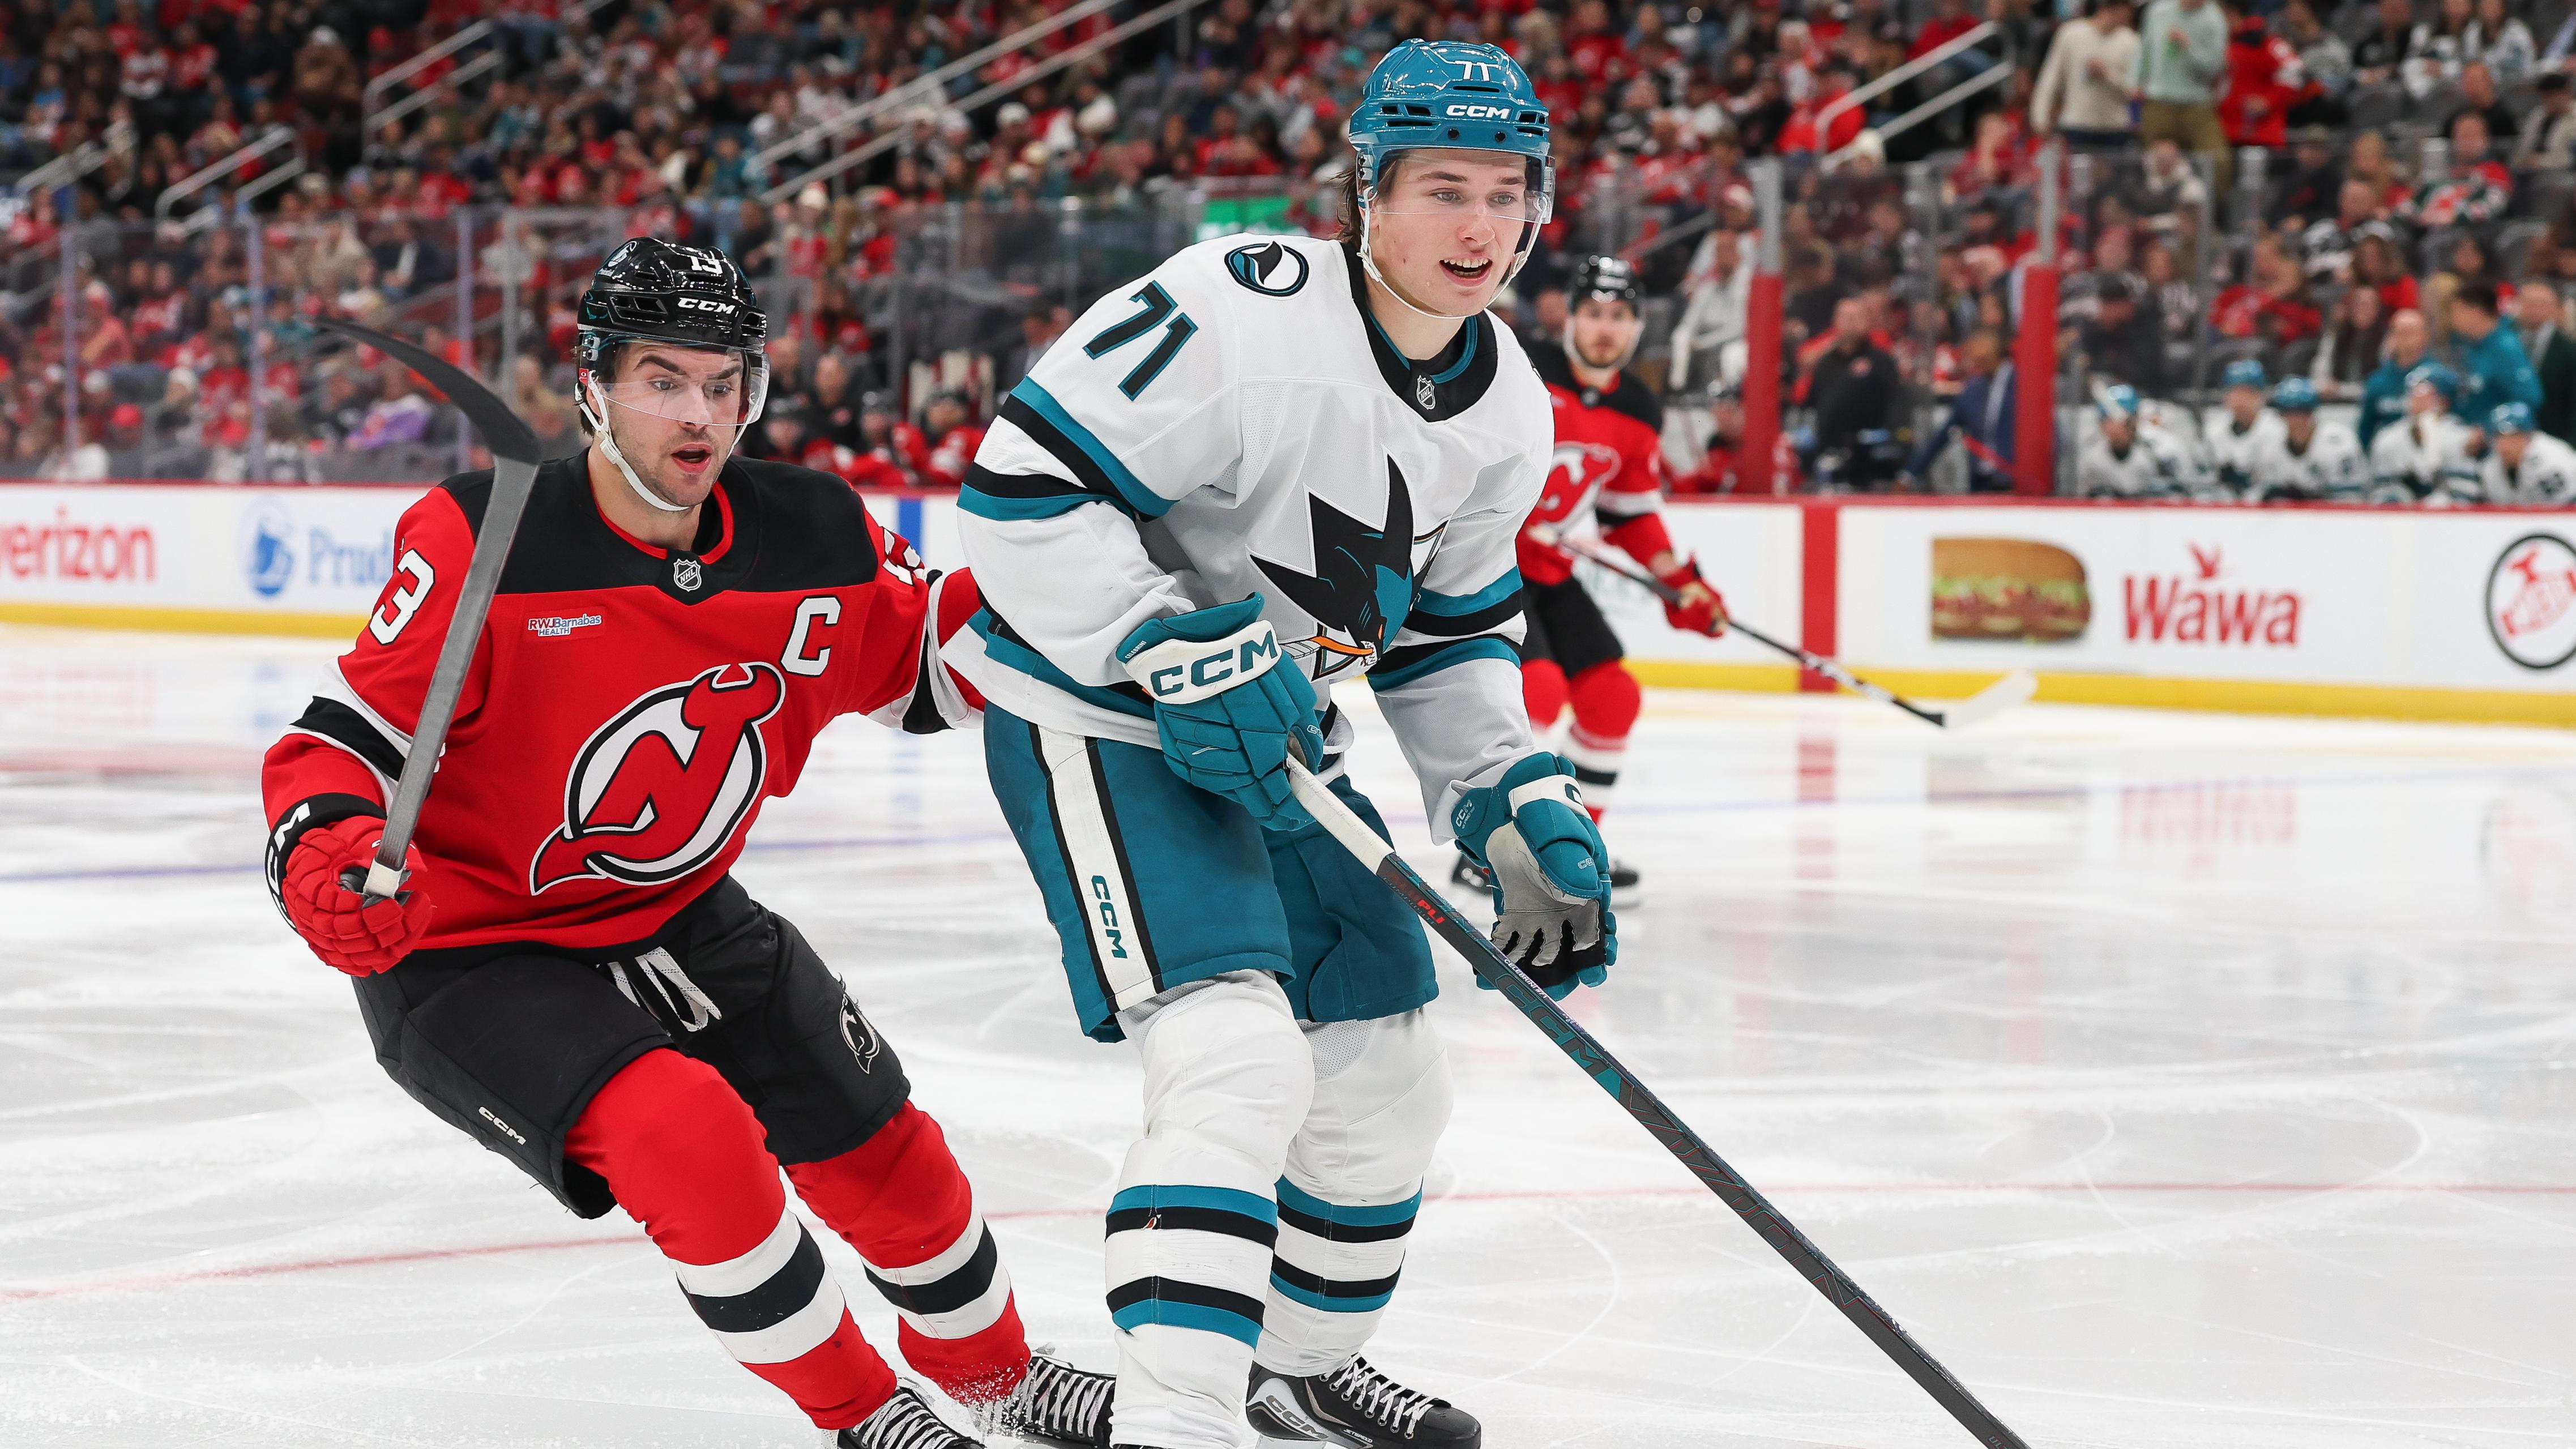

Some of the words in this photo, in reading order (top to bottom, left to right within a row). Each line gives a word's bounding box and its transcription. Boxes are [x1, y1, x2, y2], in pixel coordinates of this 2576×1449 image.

[1455, 61, 1491, 82] 71
[1446, 105, 1510, 119] CCM
[678, 298, 736, 314] CCM
[1082, 280, 1199, 401] 71
[1421, 387, 1431, 400] NHL
[369, 535, 435, 646] 3
[680, 569, 695, 584] NHL
[2122, 574, 2298, 644] Wawa
[781, 596, 841, 677] C
[1150, 630, 1278, 696] CCM
[1456, 800, 1472, 827] CCM
[1091, 874, 1128, 959] CCM
[1504, 959, 1538, 992] CELEBRINI
[1495, 973, 1609, 1077] CCM
[478, 1106, 527, 1146] CCM
[1266, 1395, 1329, 1439] CCM
